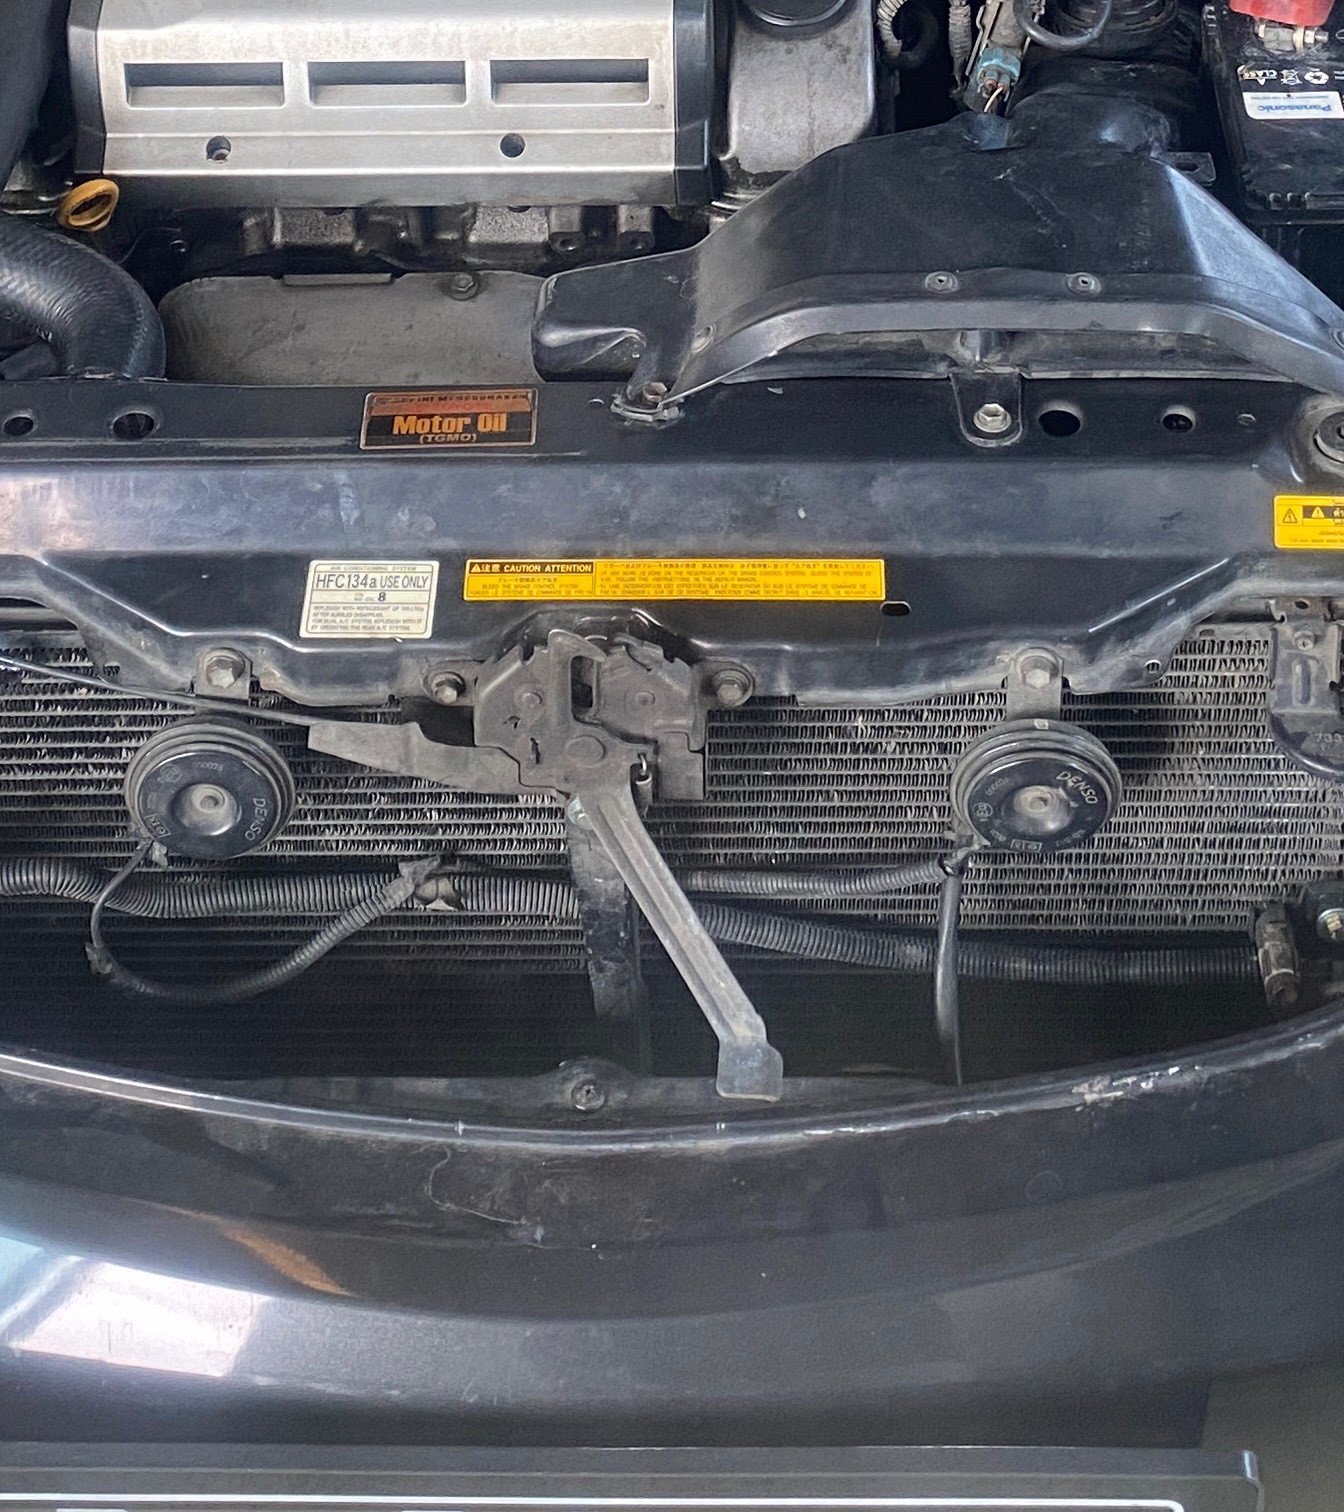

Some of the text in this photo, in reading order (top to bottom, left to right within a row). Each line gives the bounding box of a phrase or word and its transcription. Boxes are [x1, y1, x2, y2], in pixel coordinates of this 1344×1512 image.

[1258, 104, 1332, 113] Panasonic
[392, 412, 507, 436] Motor Oil
[419, 433, 477, 445] (TGMO)
[481, 564, 501, 573] 注意
[503, 564, 541, 573] CAUTION
[544, 564, 592, 573] ATTENTION
[316, 573, 429, 589] HFC134a USE ONLY
[377, 591, 387, 602] 8
[1055, 770, 1099, 805] DENSO
[244, 796, 268, 841] DENSO
